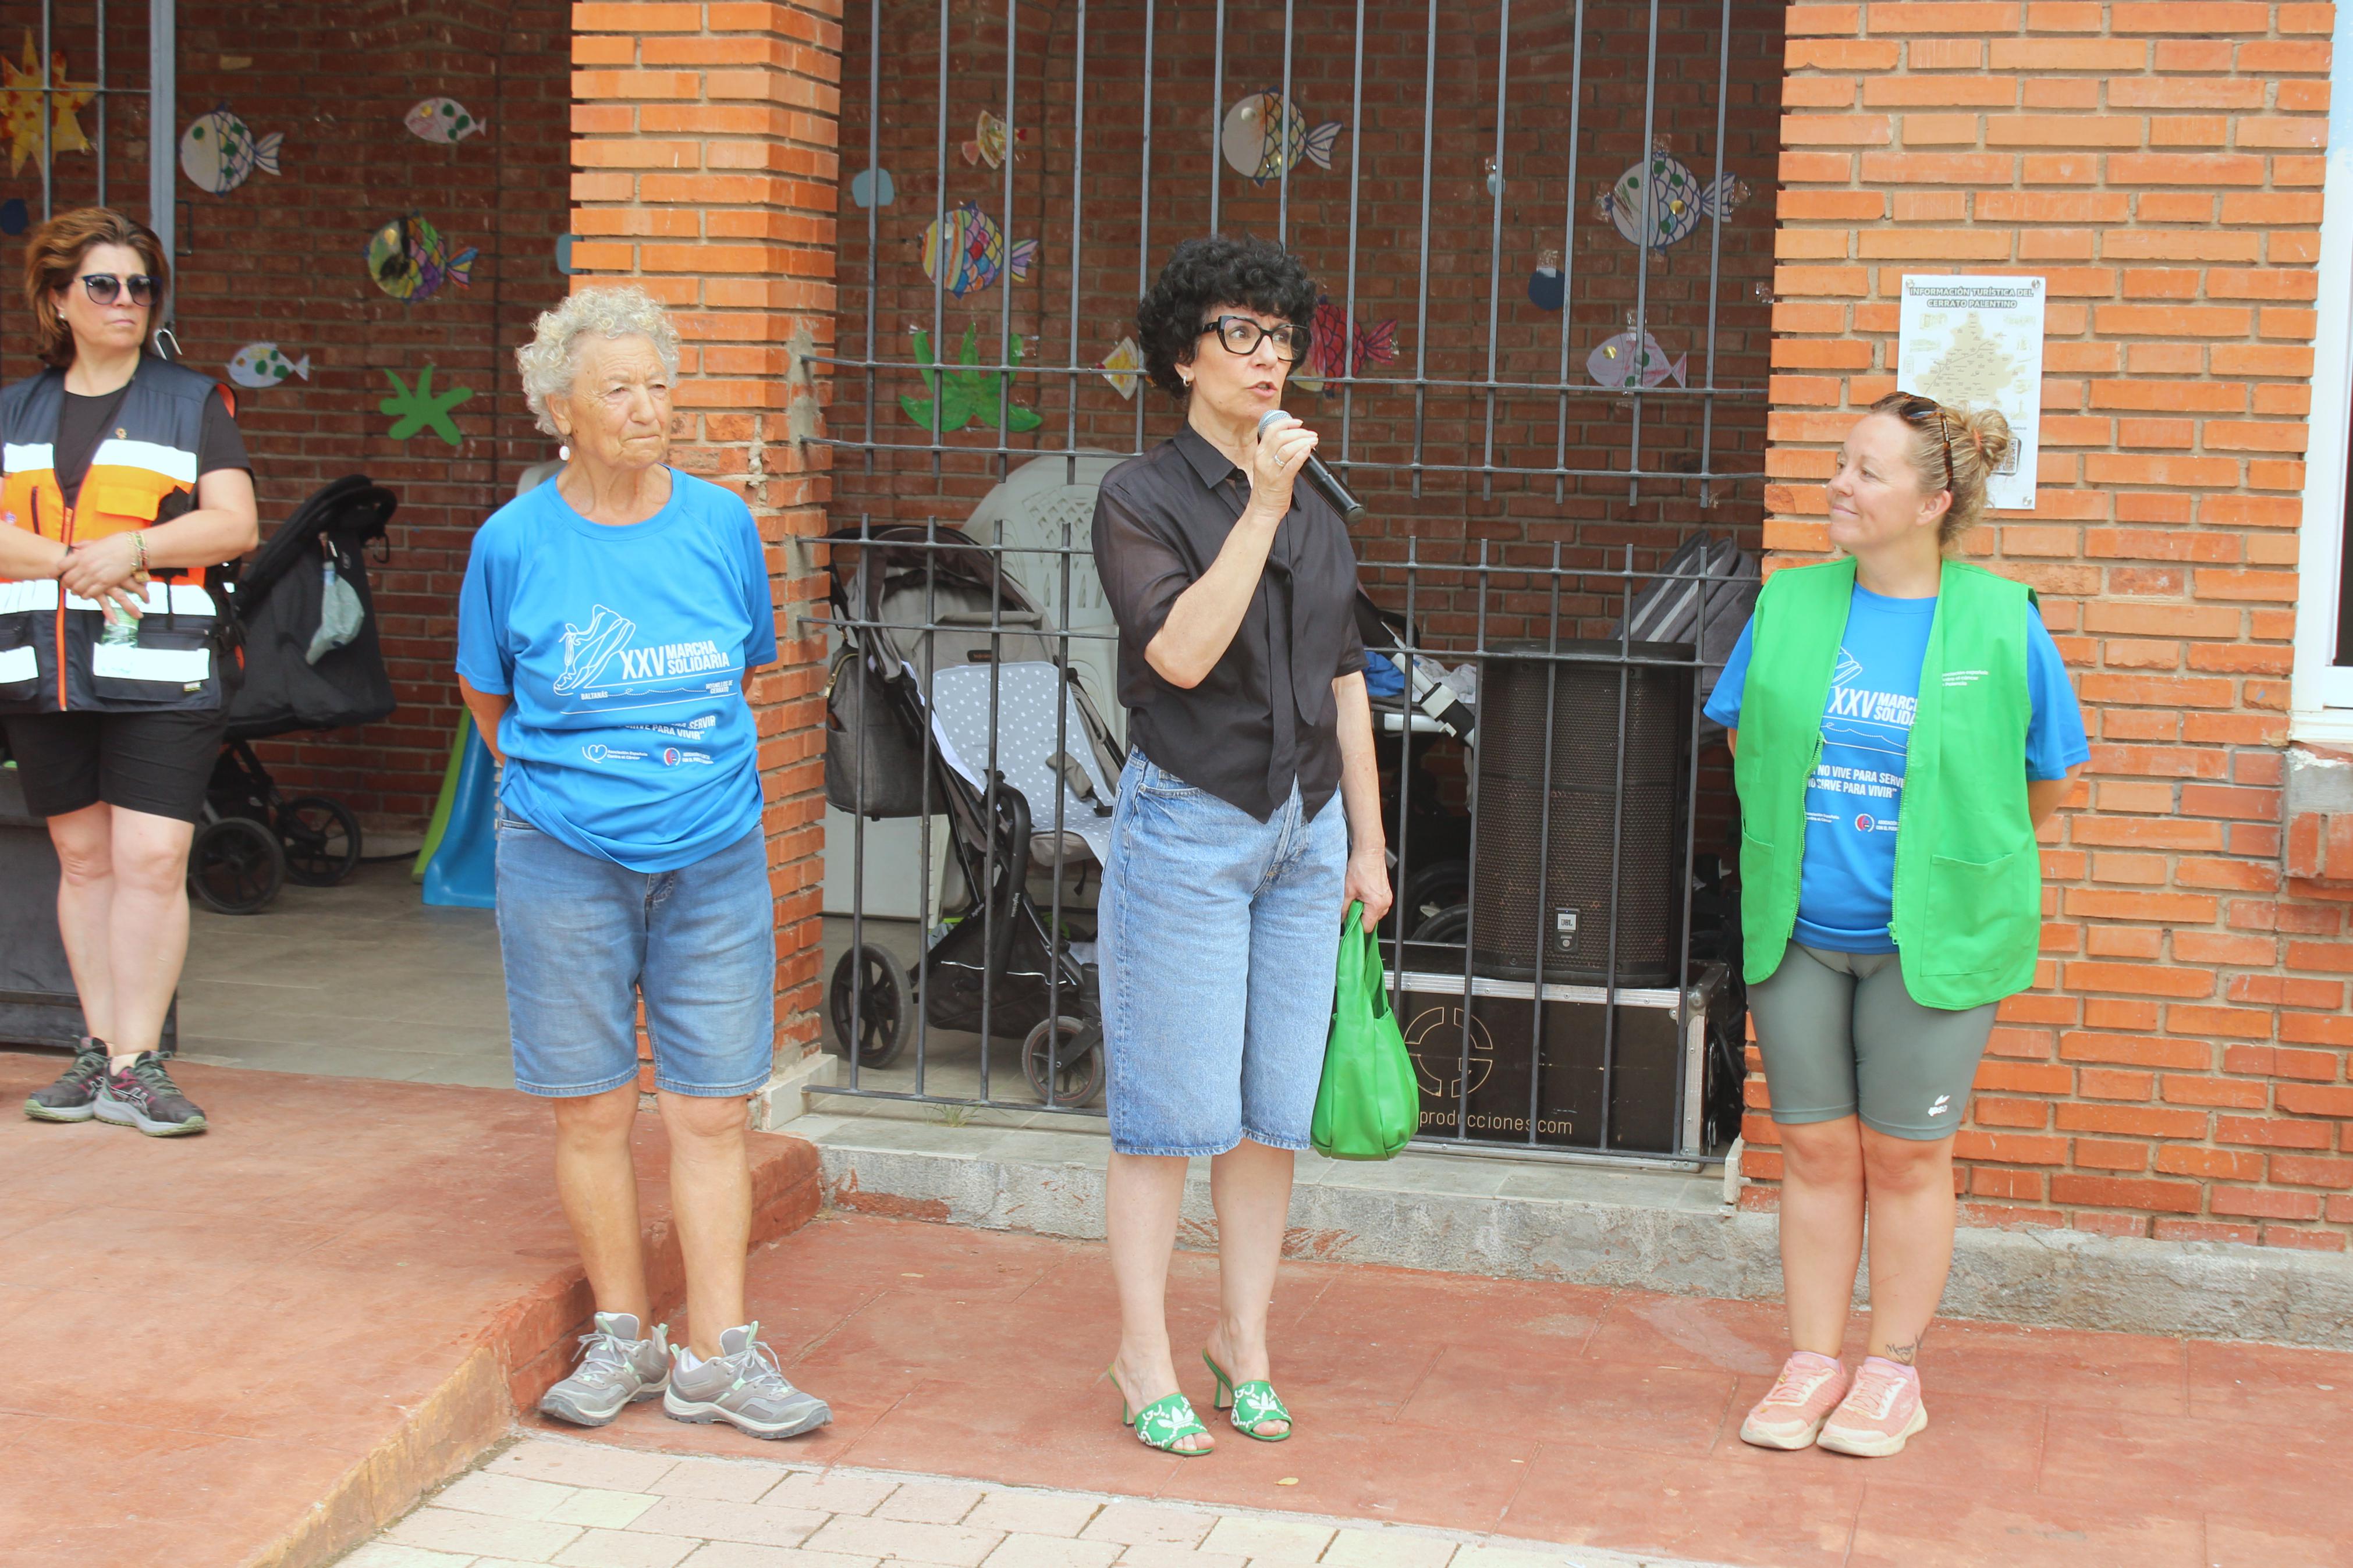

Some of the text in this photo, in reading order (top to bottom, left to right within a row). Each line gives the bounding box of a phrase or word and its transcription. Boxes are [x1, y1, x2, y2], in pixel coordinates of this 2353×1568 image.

[1910, 286, 2033, 297] INFORMACIÓN TURÍSTICA DEL
[1927, 299, 2017, 308] CERRATO PALENTINO
[619, 640, 718, 680] XXV MARCHA
[668, 652, 730, 675] SOLIDARIA
[581, 690, 608, 700] BALTANÁS
[1827, 687, 1879, 719] XXV
[652, 724, 675, 735] PARA
[688, 715, 716, 730] SERVIR
[1818, 764, 1830, 776] NO
[1832, 766, 1852, 780] VIVE
[1852, 769, 1877, 783] PARA
[1817, 778, 1842, 792] SIRVE
[1843, 781, 1866, 795] PARA
[1868, 784, 1897, 798] VIVIR"
[1561, 919, 1573, 927] JBL
